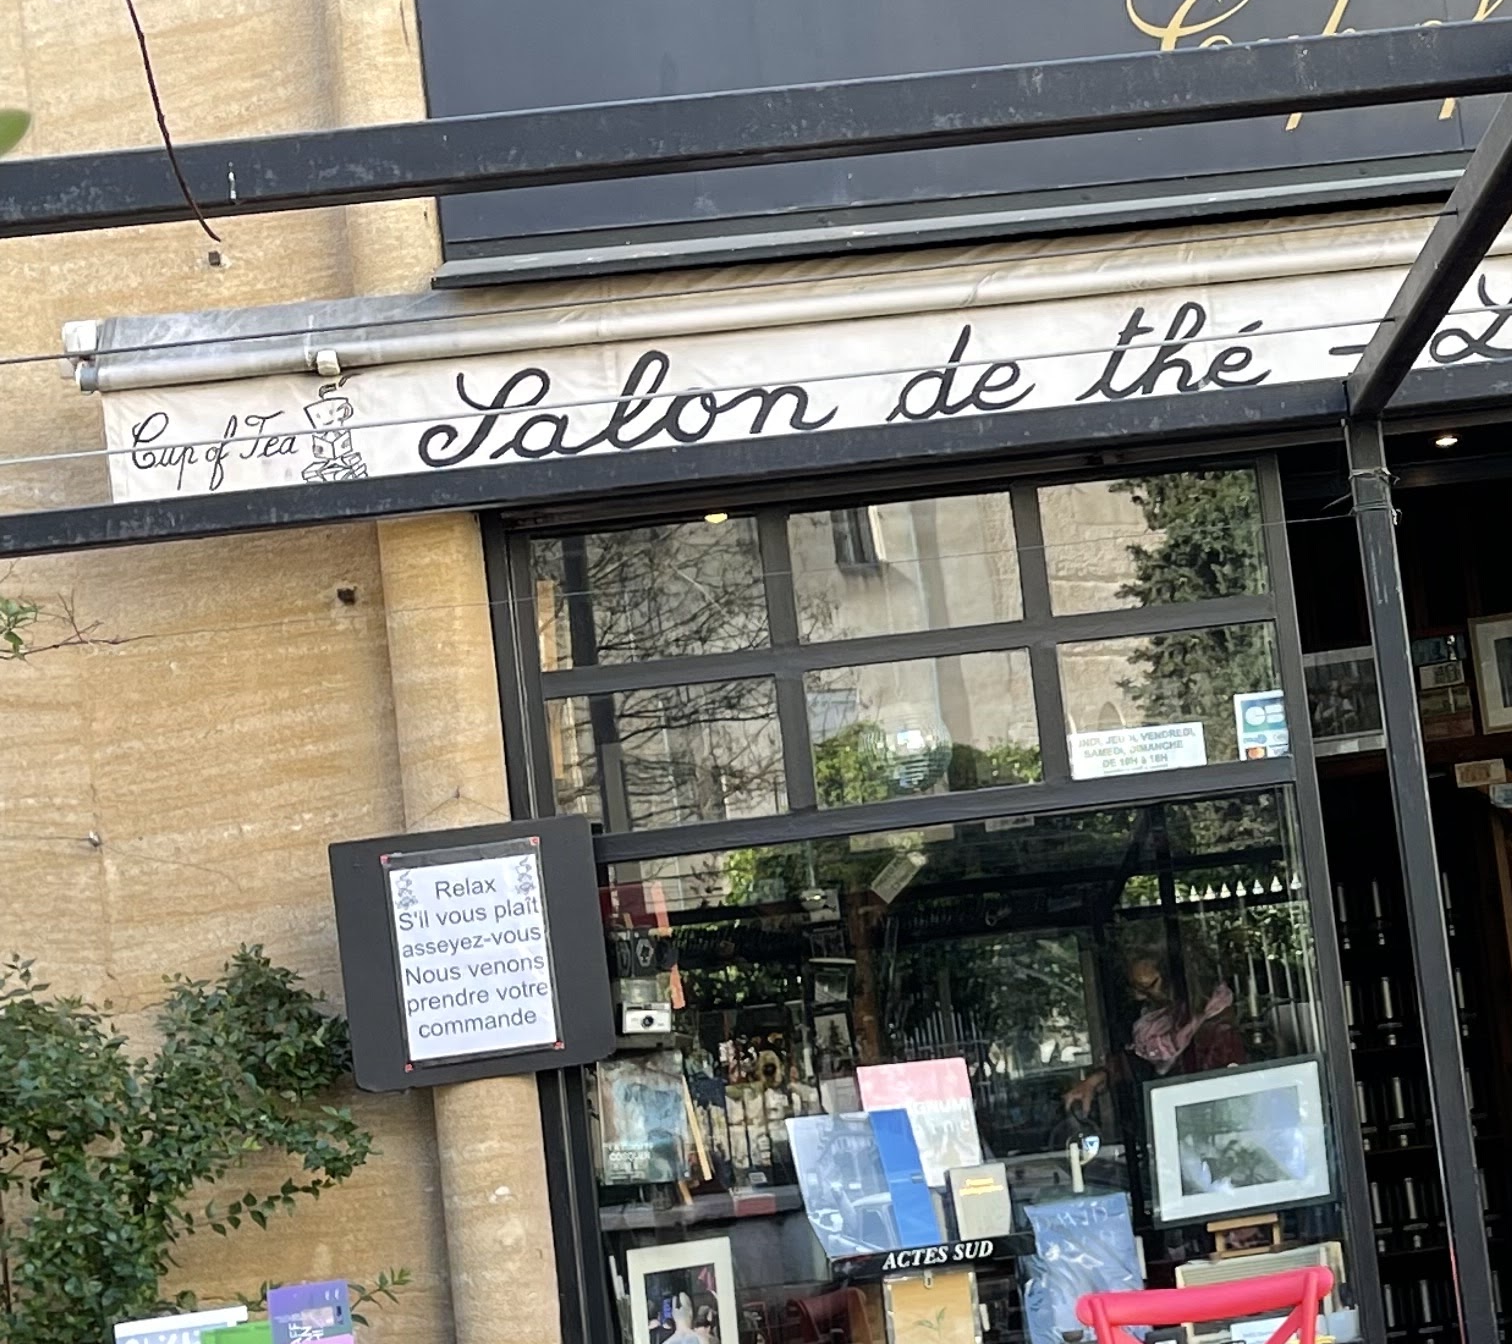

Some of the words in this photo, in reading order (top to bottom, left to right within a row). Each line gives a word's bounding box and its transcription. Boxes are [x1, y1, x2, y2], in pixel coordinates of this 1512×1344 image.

[417, 349, 837, 468] Salon
[886, 324, 1034, 423] de
[1076, 301, 1271, 402] thé
[131, 412, 198, 490] Cup
[205, 415, 236, 491] of
[240, 411, 299, 459] Tea
[434, 877, 497, 899] Relax
[398, 909, 430, 932] S'il
[435, 905, 488, 926] vous
[494, 896, 540, 923] plaît
[402, 925, 542, 959] asseyez-vous
[405, 965, 462, 986] Nous
[467, 955, 545, 978] venons
[407, 987, 490, 1016] prendre
[495, 981, 549, 1002] votre
[418, 1007, 538, 1039] commande
[882, 1244, 949, 1271] ACTES
[953, 1240, 994, 1262] SUD
